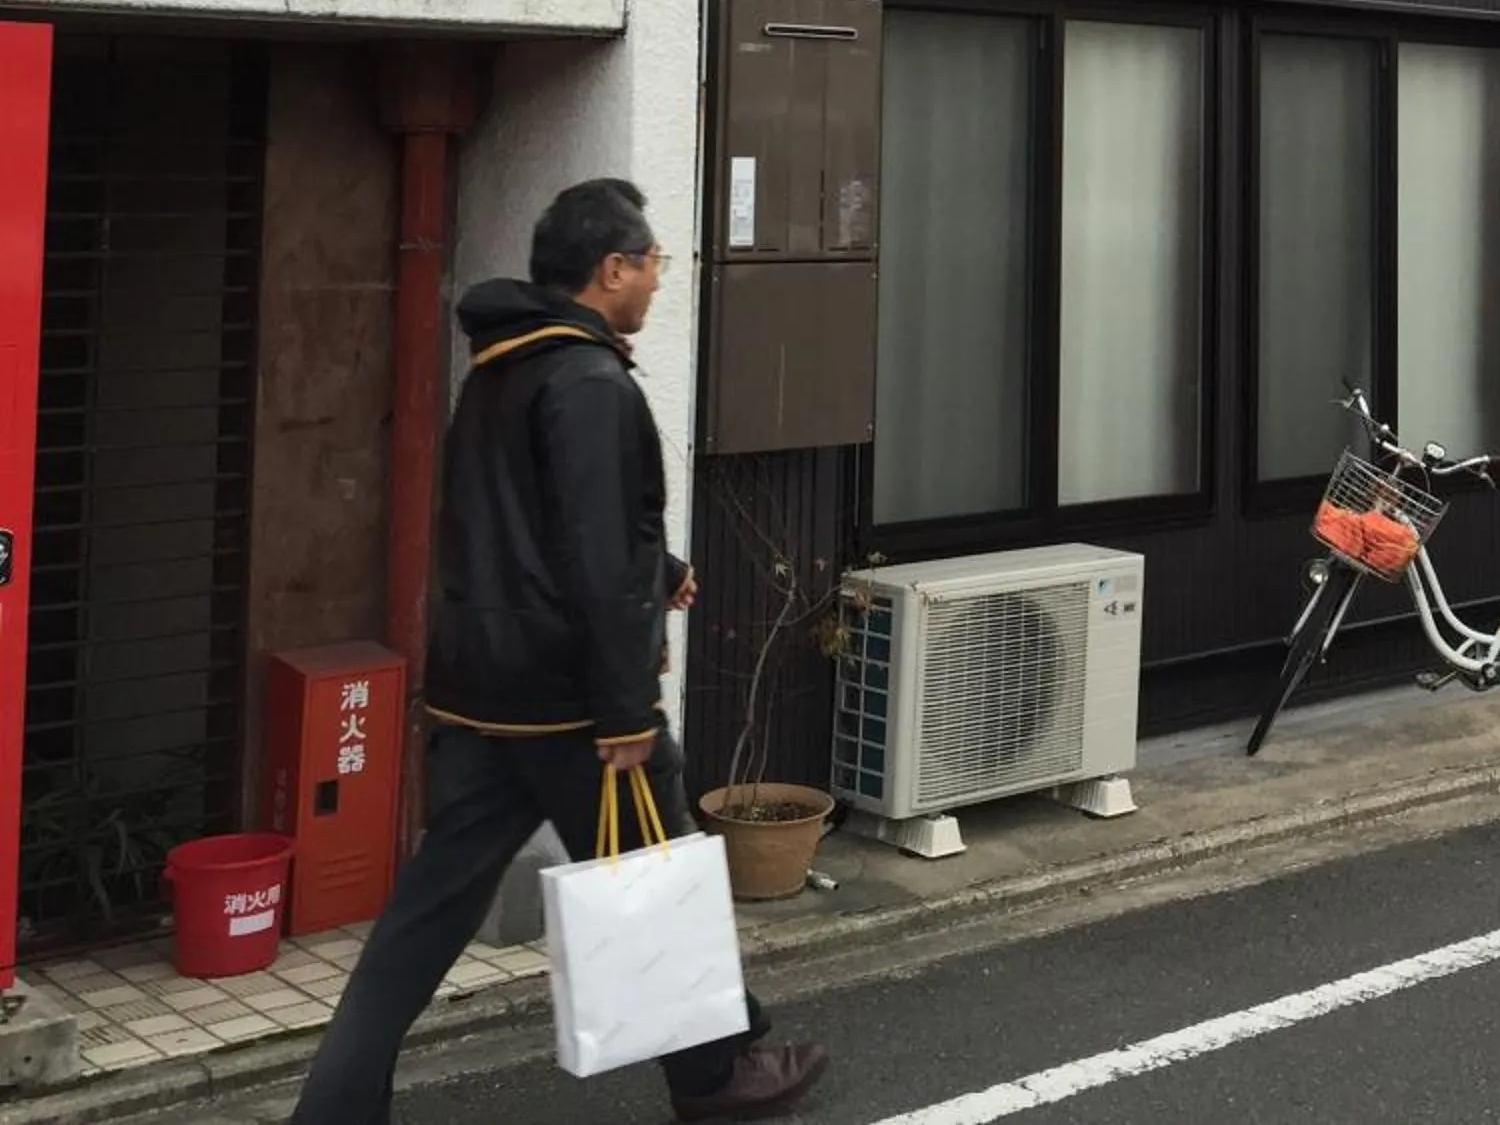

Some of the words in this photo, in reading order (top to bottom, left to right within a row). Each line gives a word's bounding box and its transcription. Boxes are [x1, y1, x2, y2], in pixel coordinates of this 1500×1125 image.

[337, 680, 369, 774] 消火器
[224, 883, 281, 915] 消火用
